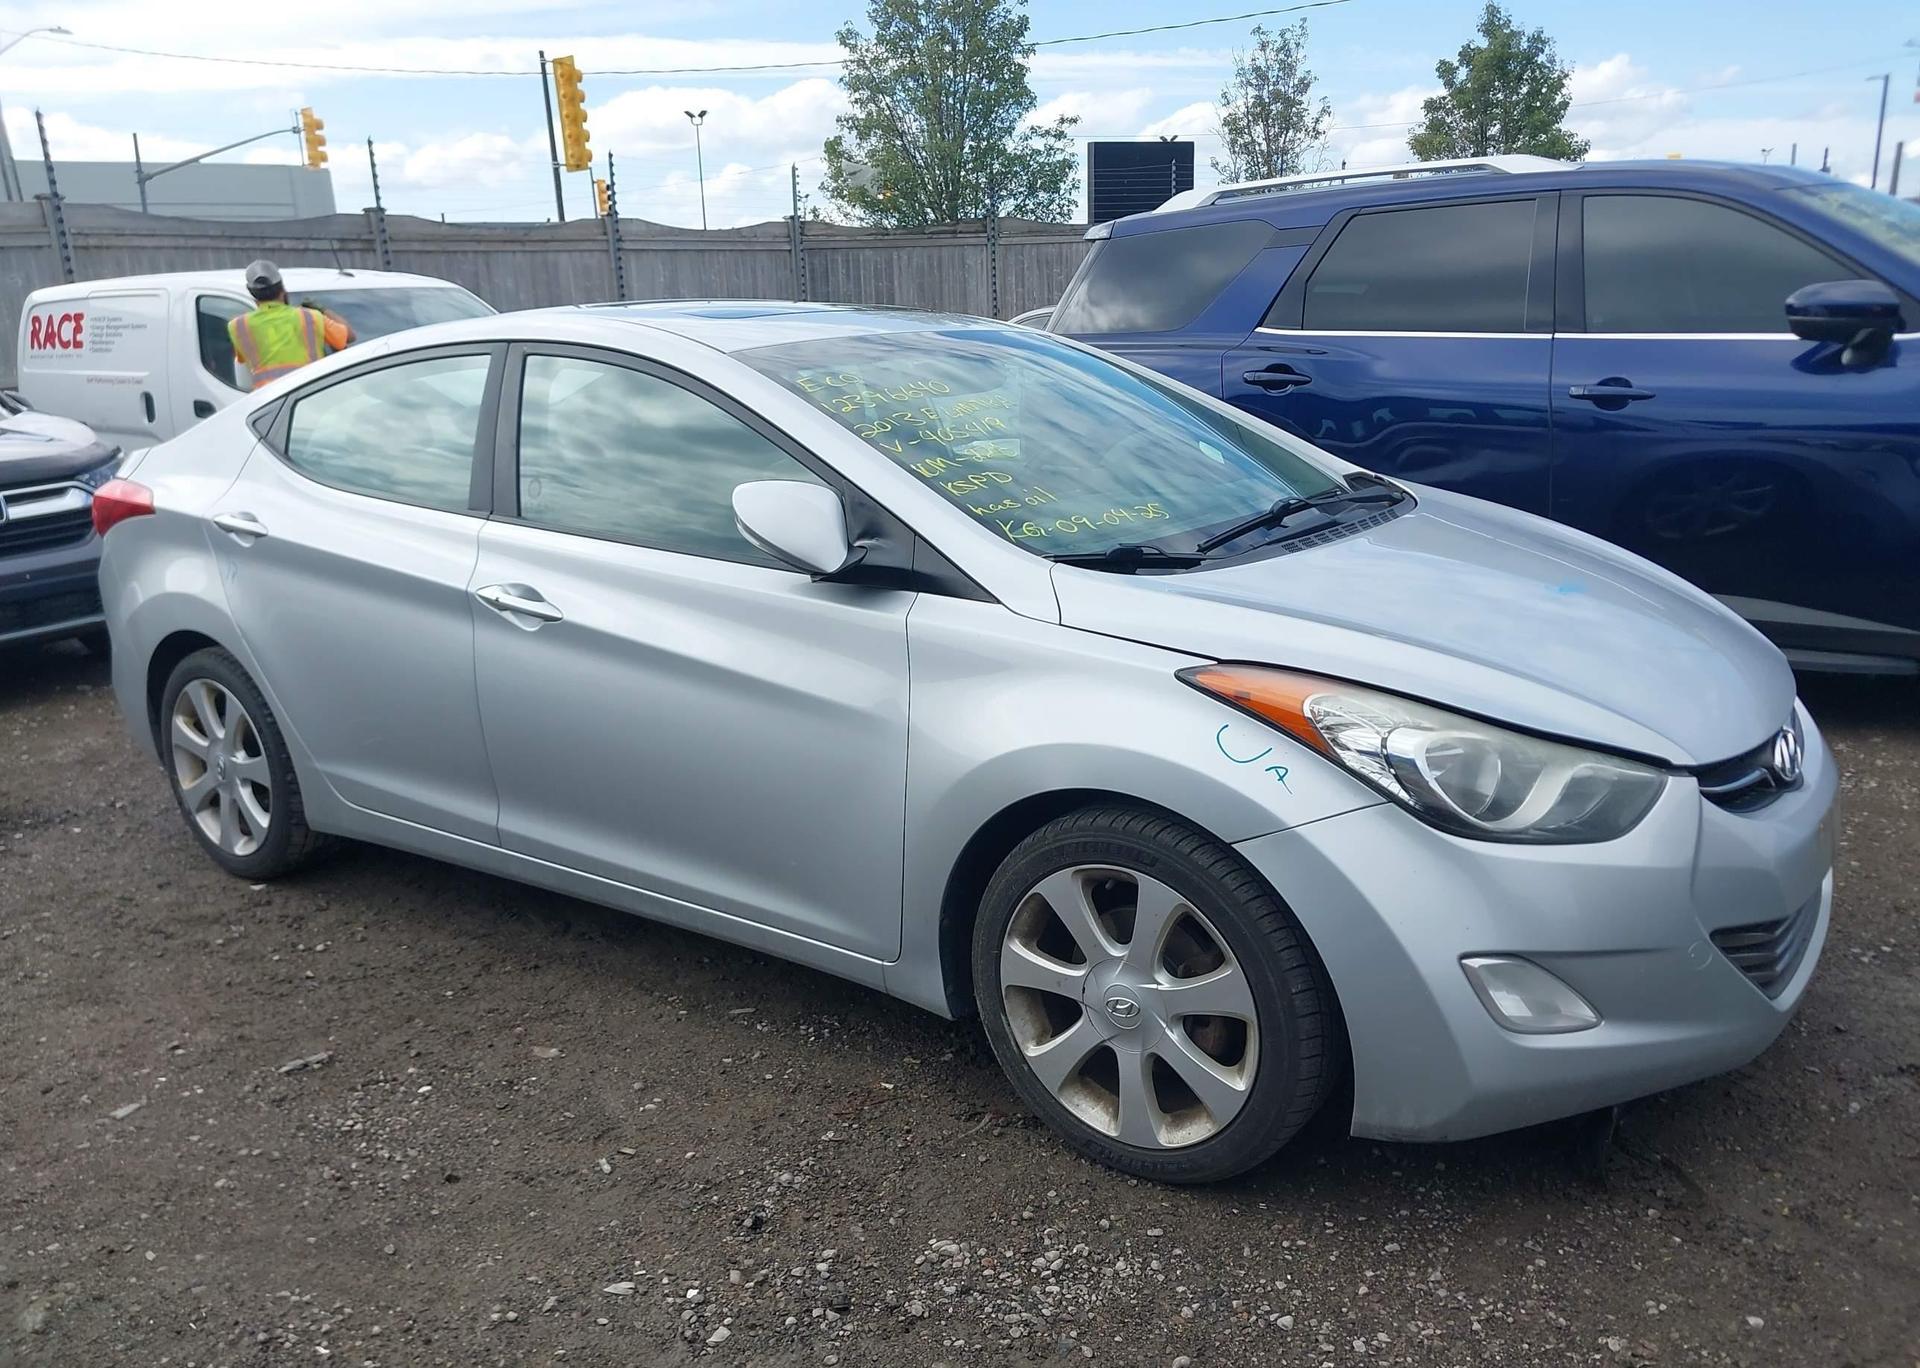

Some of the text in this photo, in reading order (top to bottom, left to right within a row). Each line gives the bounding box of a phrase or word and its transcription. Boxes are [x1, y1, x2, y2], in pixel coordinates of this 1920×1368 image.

[30, 312, 85, 350] RACE
[853, 411, 927, 439] 2013
[1022, 486, 1058, 506] oil
